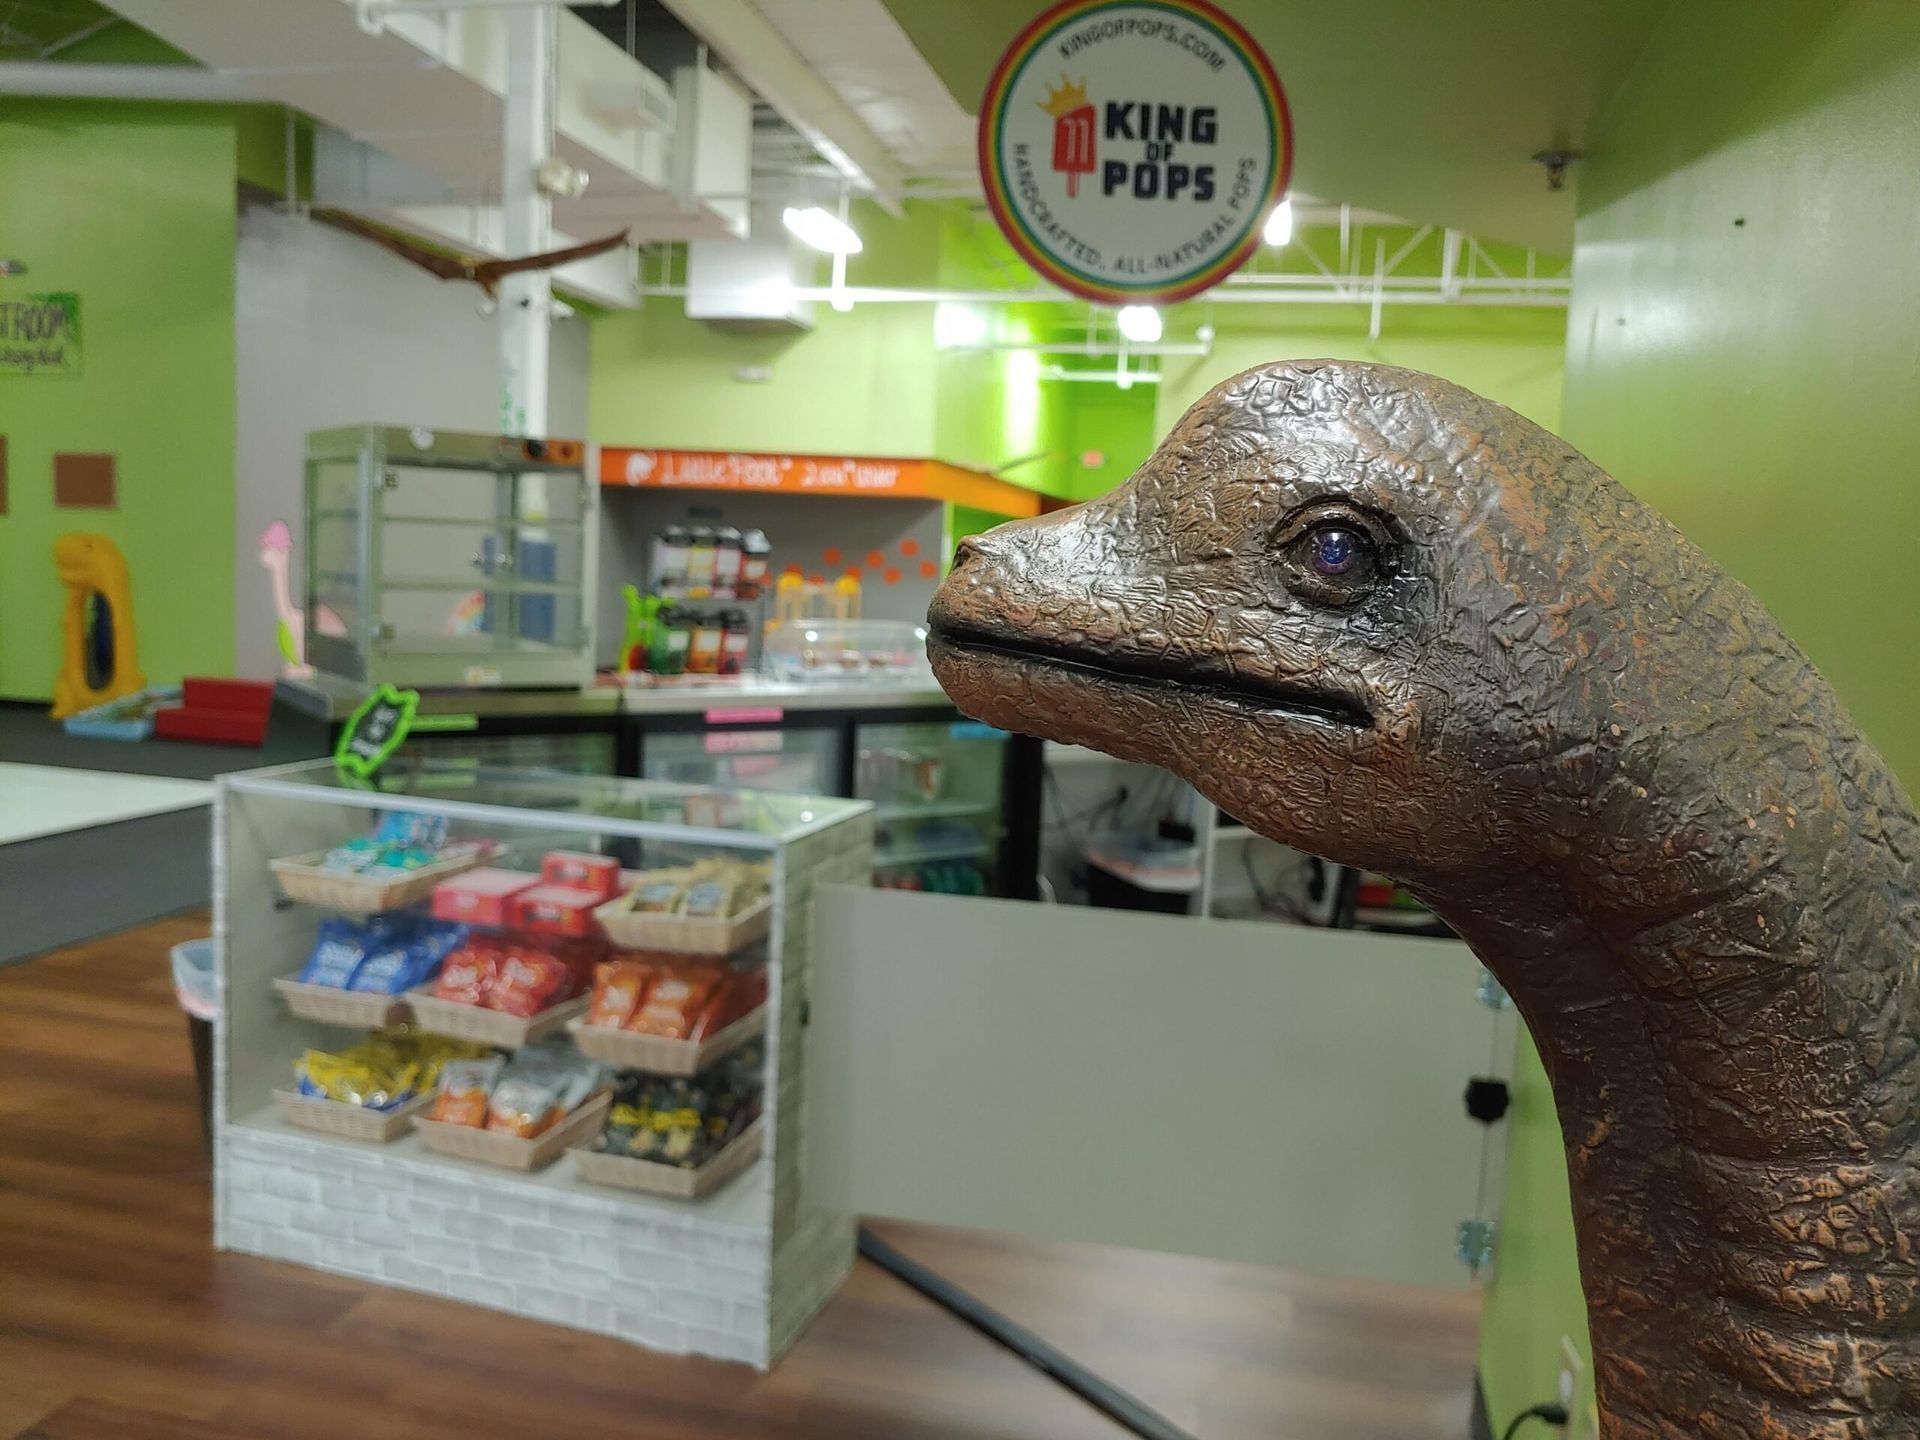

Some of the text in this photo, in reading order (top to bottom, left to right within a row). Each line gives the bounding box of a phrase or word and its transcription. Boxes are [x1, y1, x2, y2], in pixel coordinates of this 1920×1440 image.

[1058, 18, 1226, 72] KINGOFPOPS.COM
[1106, 102, 1216, 143] KING
[1147, 143, 1173, 162] OF
[1104, 160, 1215, 201] POPS
[1227, 157, 1257, 210] POPS
